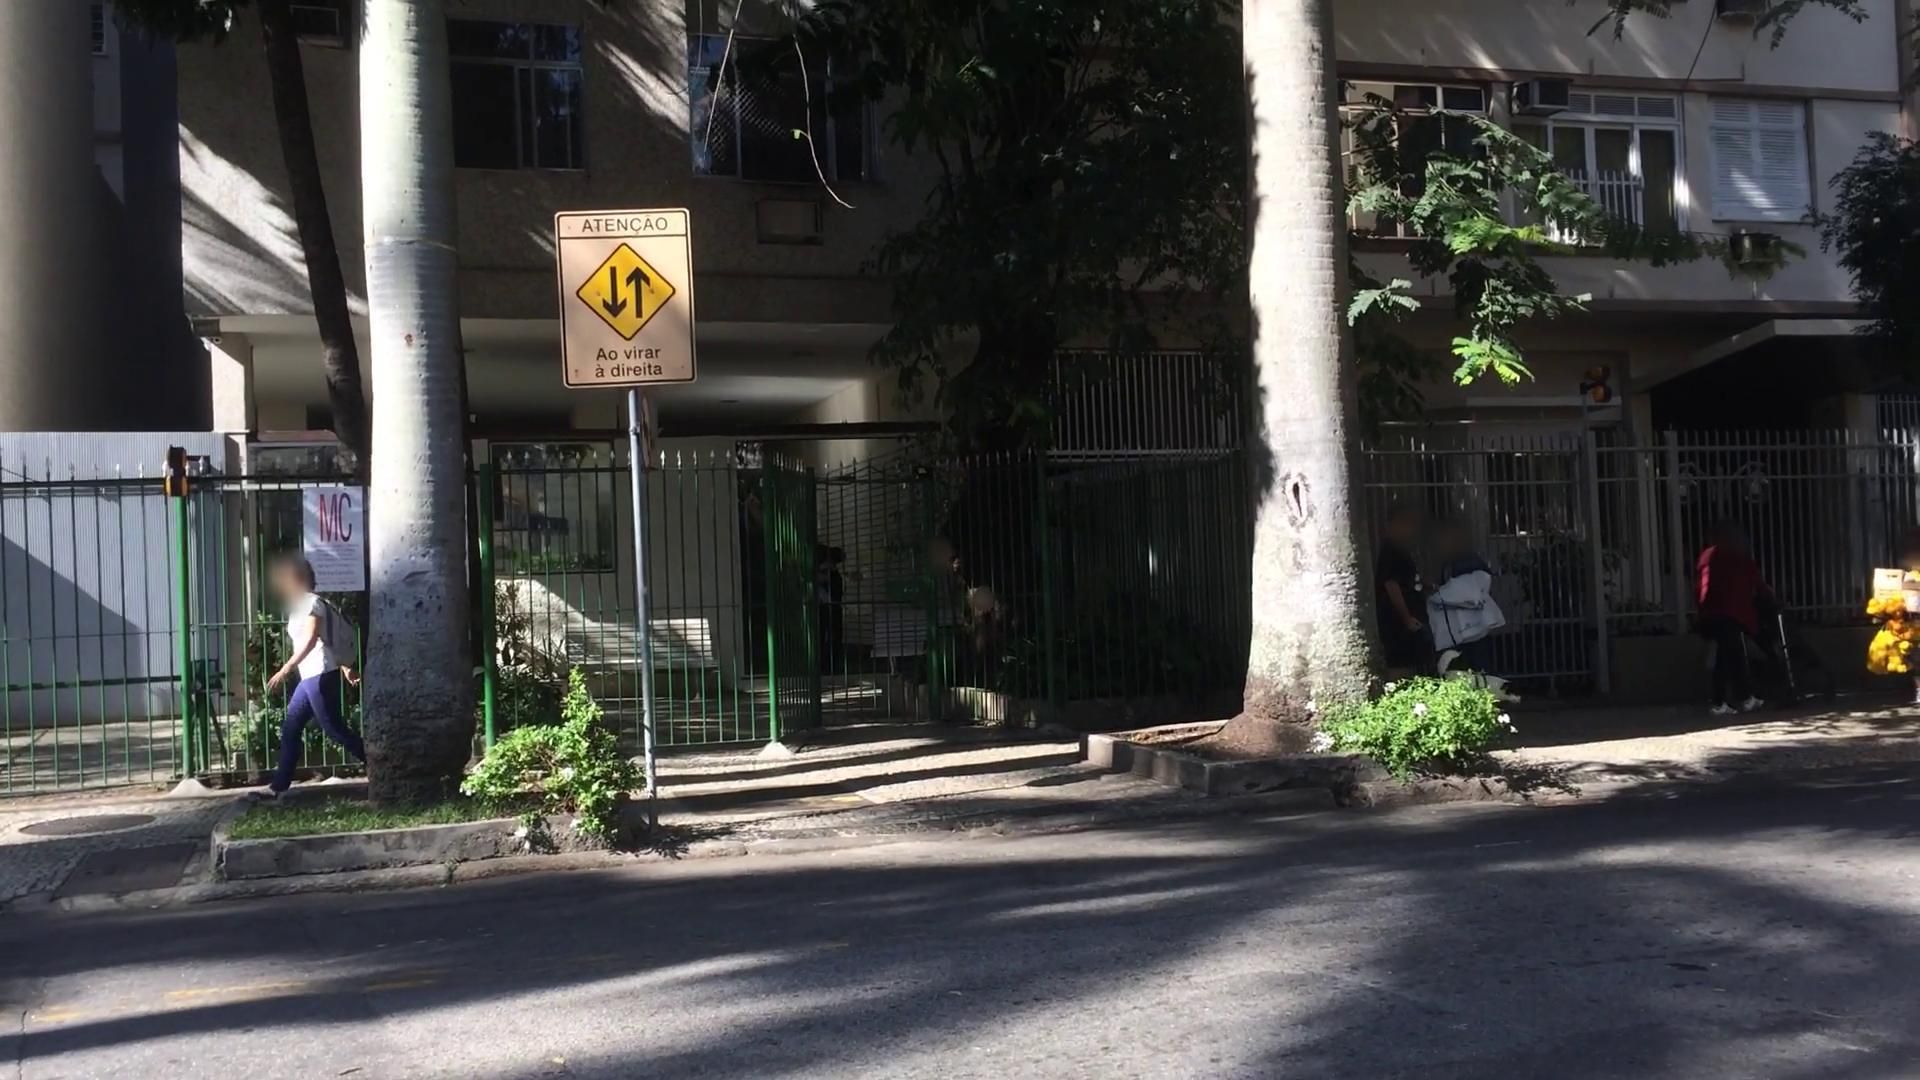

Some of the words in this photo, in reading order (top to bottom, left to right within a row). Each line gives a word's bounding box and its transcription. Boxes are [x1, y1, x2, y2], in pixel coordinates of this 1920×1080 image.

[582, 215, 668, 234] ATENÇÃO
[596, 348, 618, 361] Ao
[624, 346, 660, 360] virar
[595, 365, 605, 378] à
[611, 363, 663, 378] direita
[319, 493, 352, 542] MC
